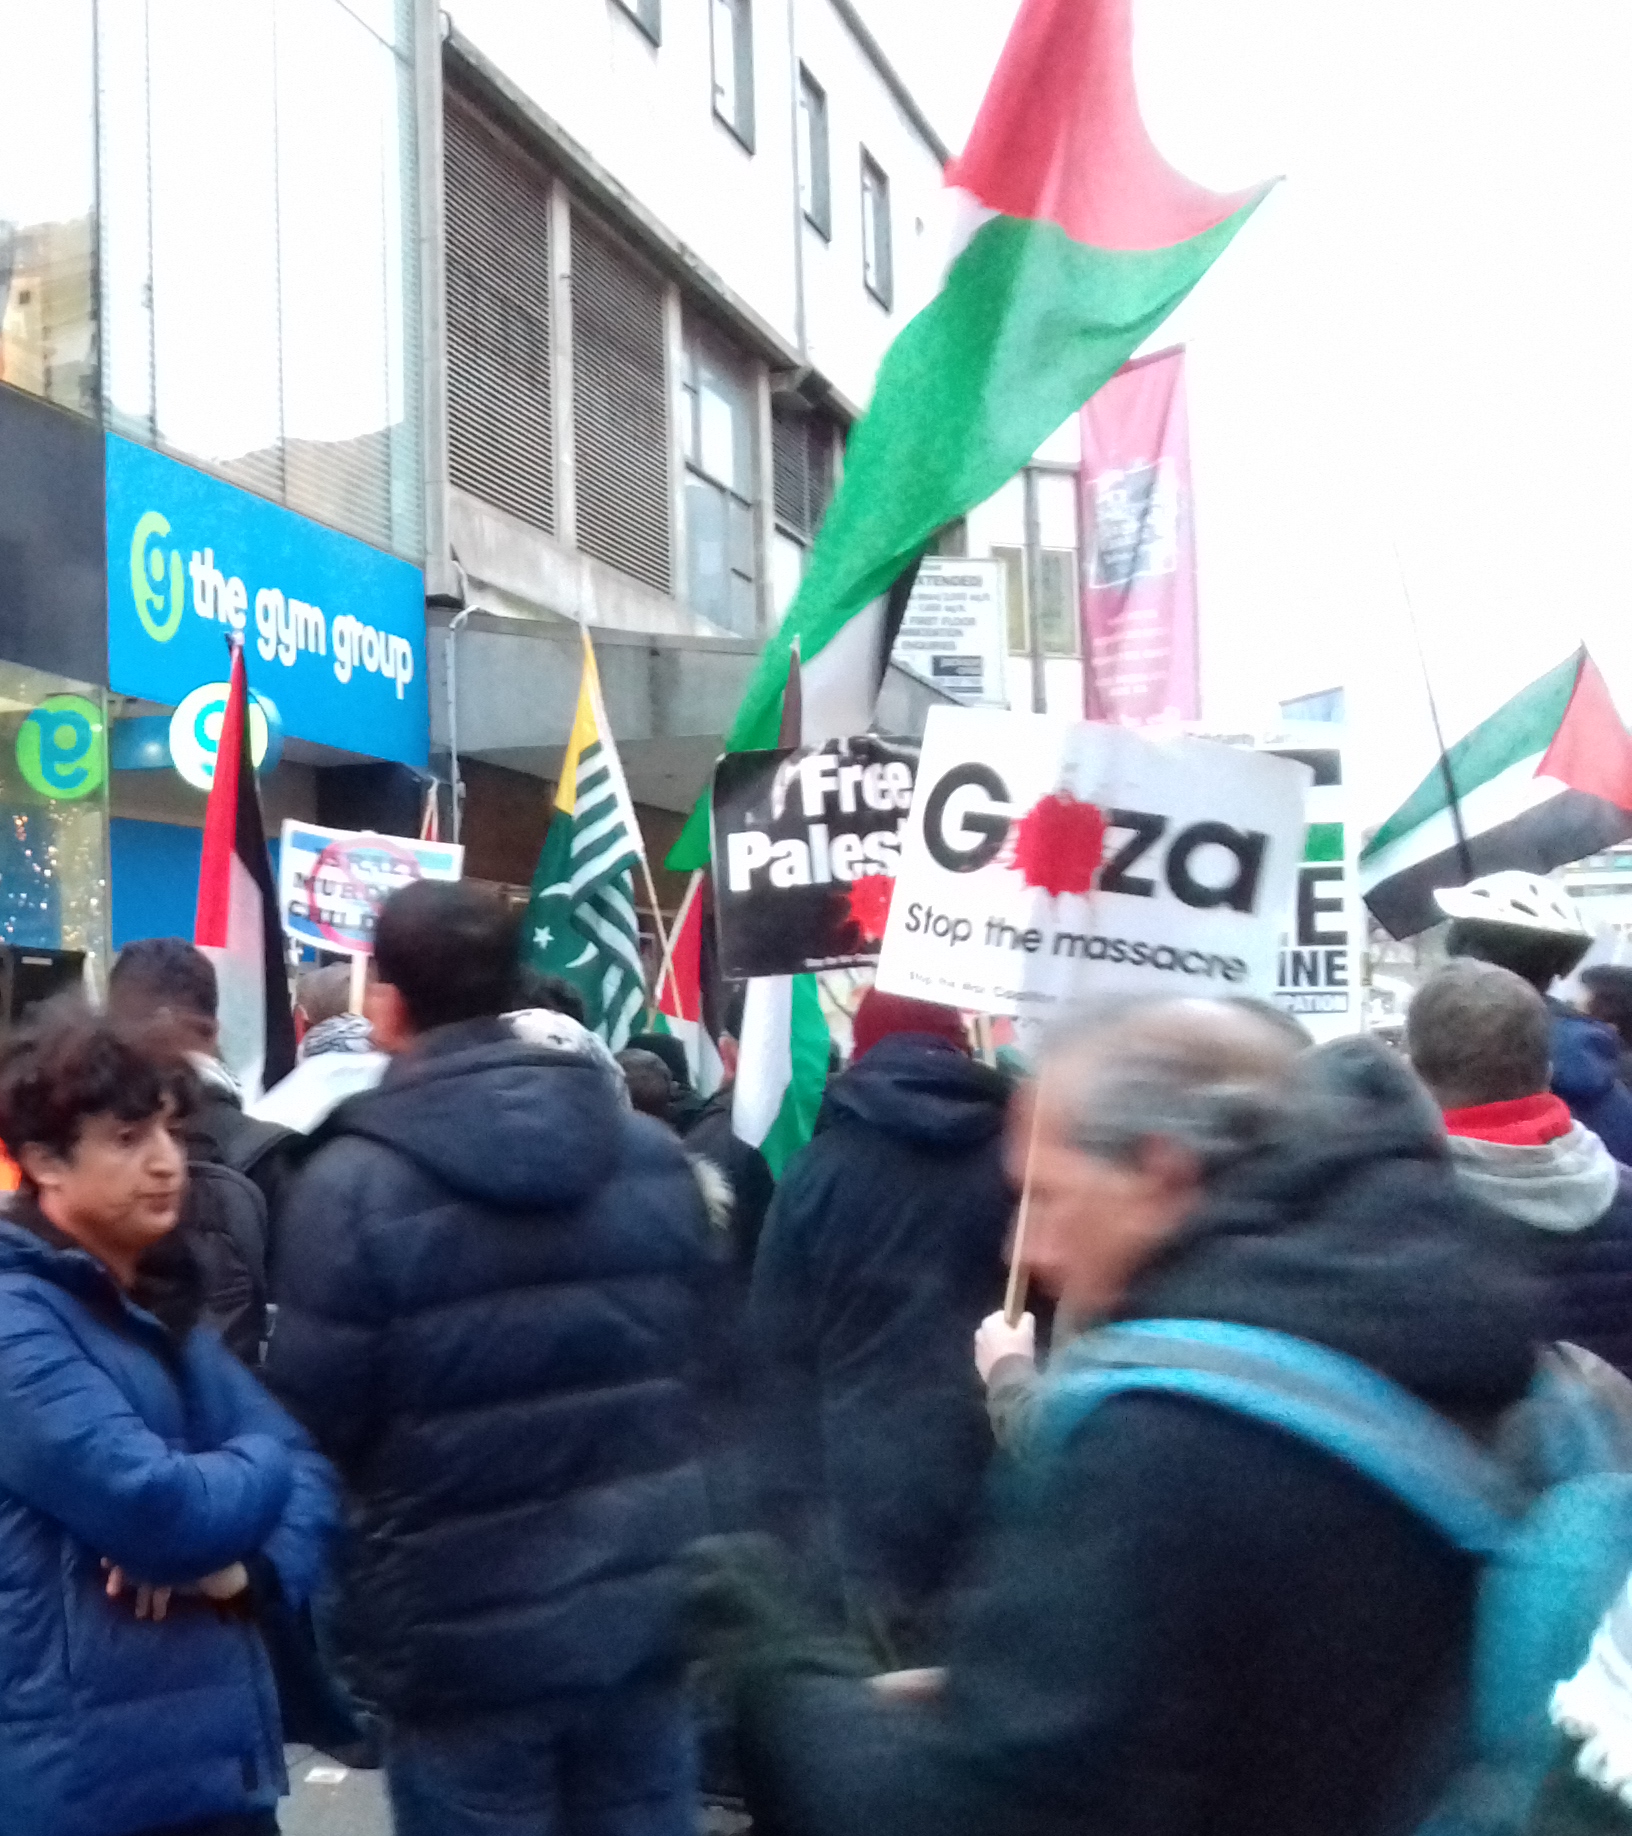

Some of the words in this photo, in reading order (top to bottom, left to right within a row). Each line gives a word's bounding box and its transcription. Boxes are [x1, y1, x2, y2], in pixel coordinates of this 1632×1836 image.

[188, 547, 248, 629] the
[254, 587, 326, 667] gym
[331, 614, 414, 700] group
[798, 752, 915, 817] Free
[923, 762, 1268, 916] Gza
[904, 902, 972, 948] Stop
[983, 914, 1042, 953] the
[1052, 930, 1249, 984] massacre
